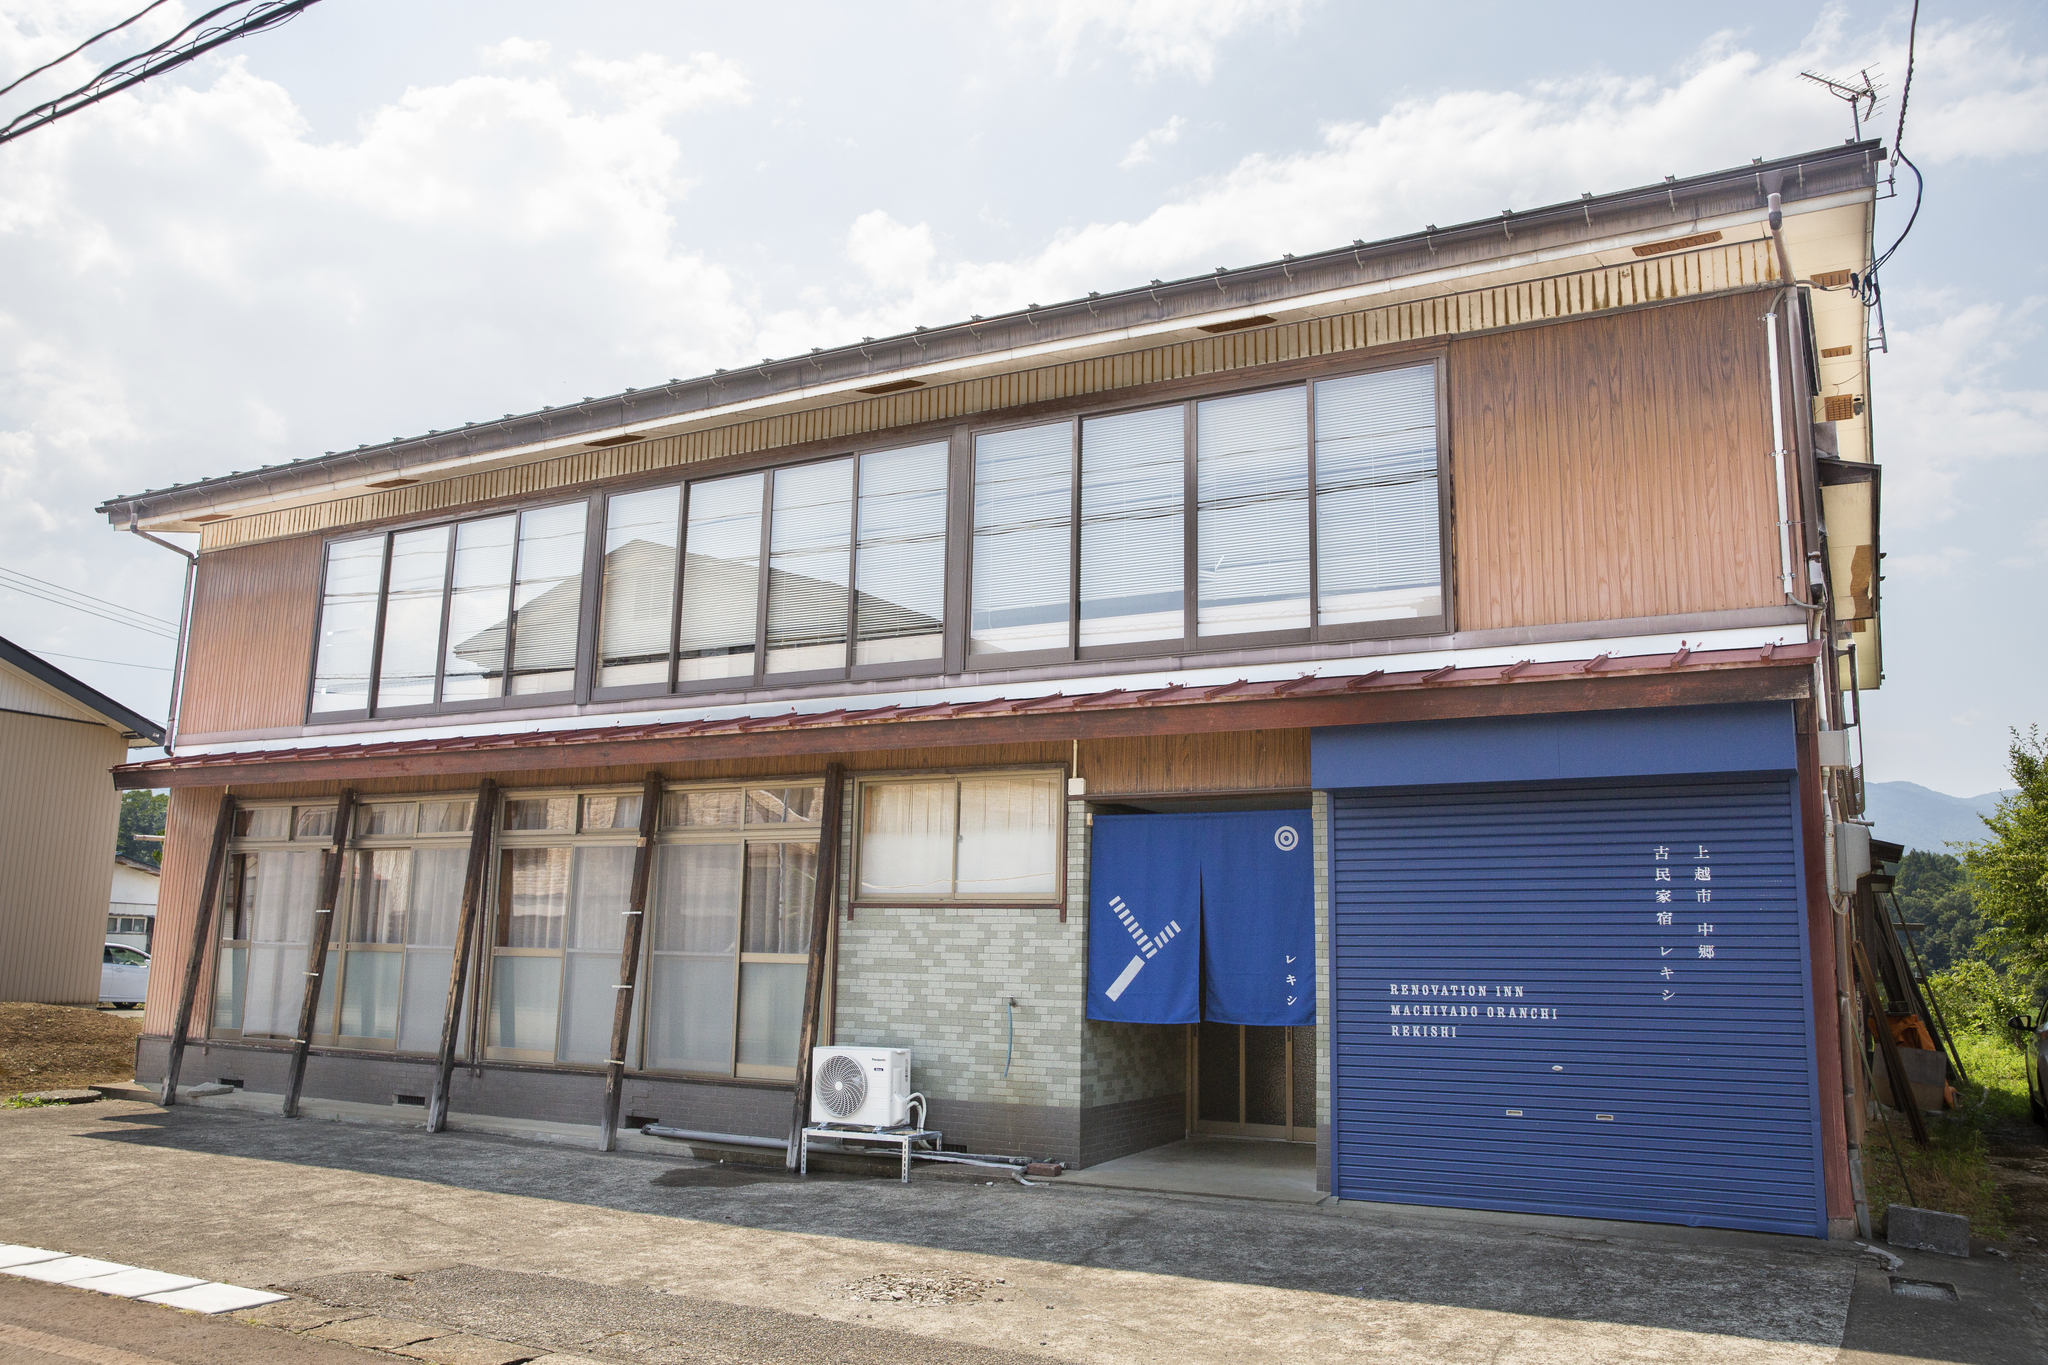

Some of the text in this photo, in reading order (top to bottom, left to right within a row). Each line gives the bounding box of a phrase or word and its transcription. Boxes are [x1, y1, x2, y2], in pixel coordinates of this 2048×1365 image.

[1694, 845, 1715, 959] 上越市 中郷
[1653, 846, 1676, 1001] 古民家宿 レキシ
[1286, 955, 1297, 1006] レキシ
[1390, 984, 1524, 997] RENOVATION INN
[1390, 1005, 1558, 1020] MACHIYADO ORANCHI
[1391, 1025, 1457, 1038] REKISHI
